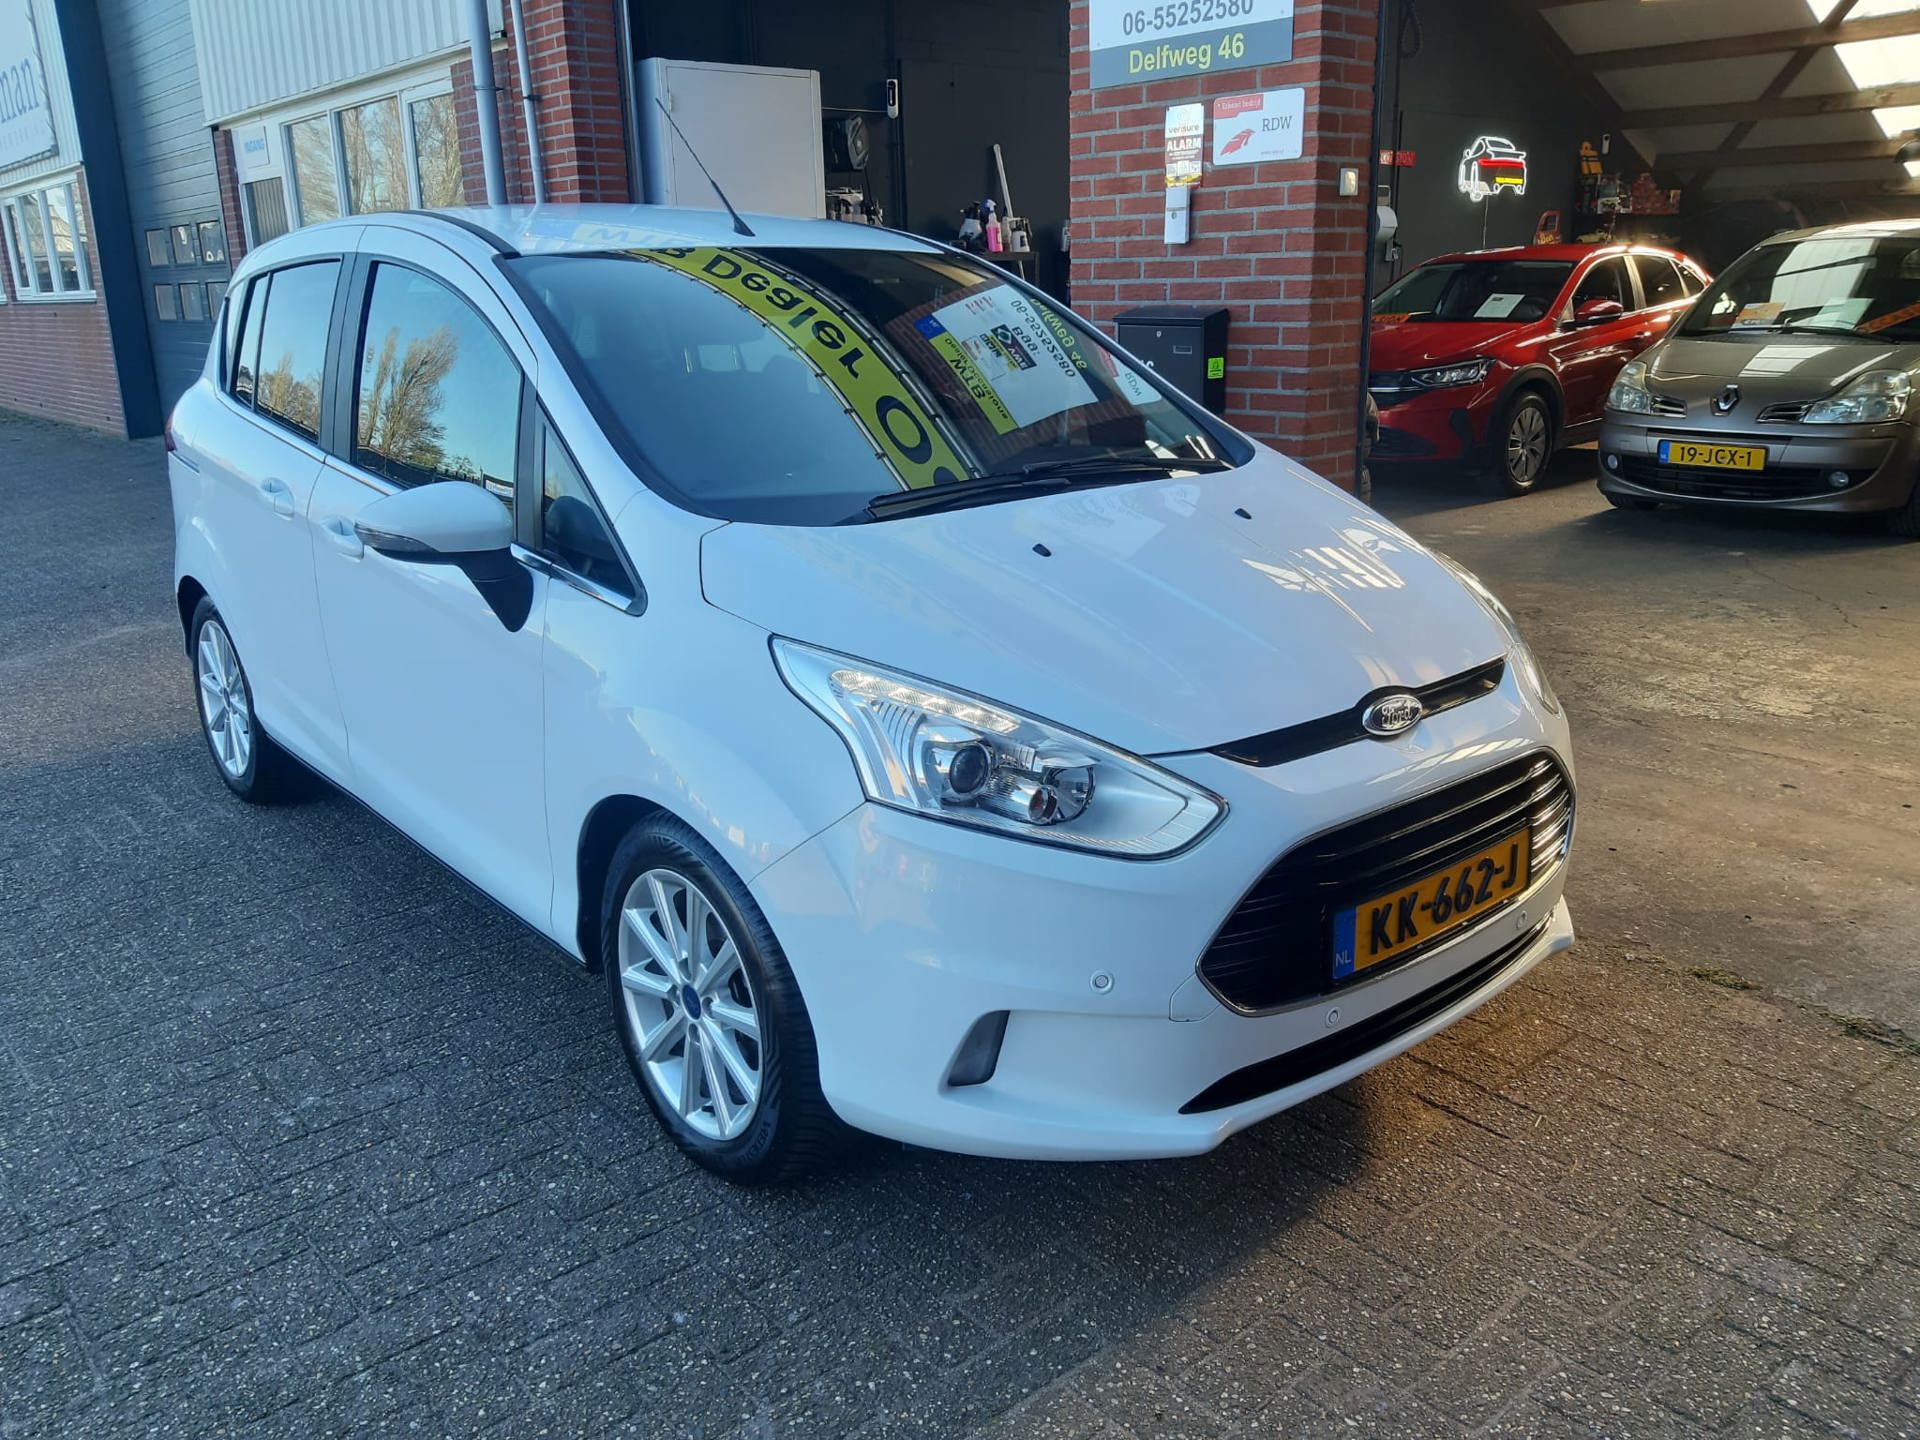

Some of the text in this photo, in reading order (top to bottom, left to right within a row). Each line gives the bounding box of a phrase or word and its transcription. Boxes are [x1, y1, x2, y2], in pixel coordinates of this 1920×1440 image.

[1123, 0, 1253, 36] 06-55252580
[1129, 32, 1245, 74] Delfweg 46
[1262, 115, 1293, 132] RDW
[1167, 137, 1201, 152] ALARM
[1680, 446, 1752, 467] 19-JGX-1
[1381, 701, 1413, 728] Ford
[1369, 842, 1521, 956] KK-662-J
[1336, 949, 1352, 968] NL
